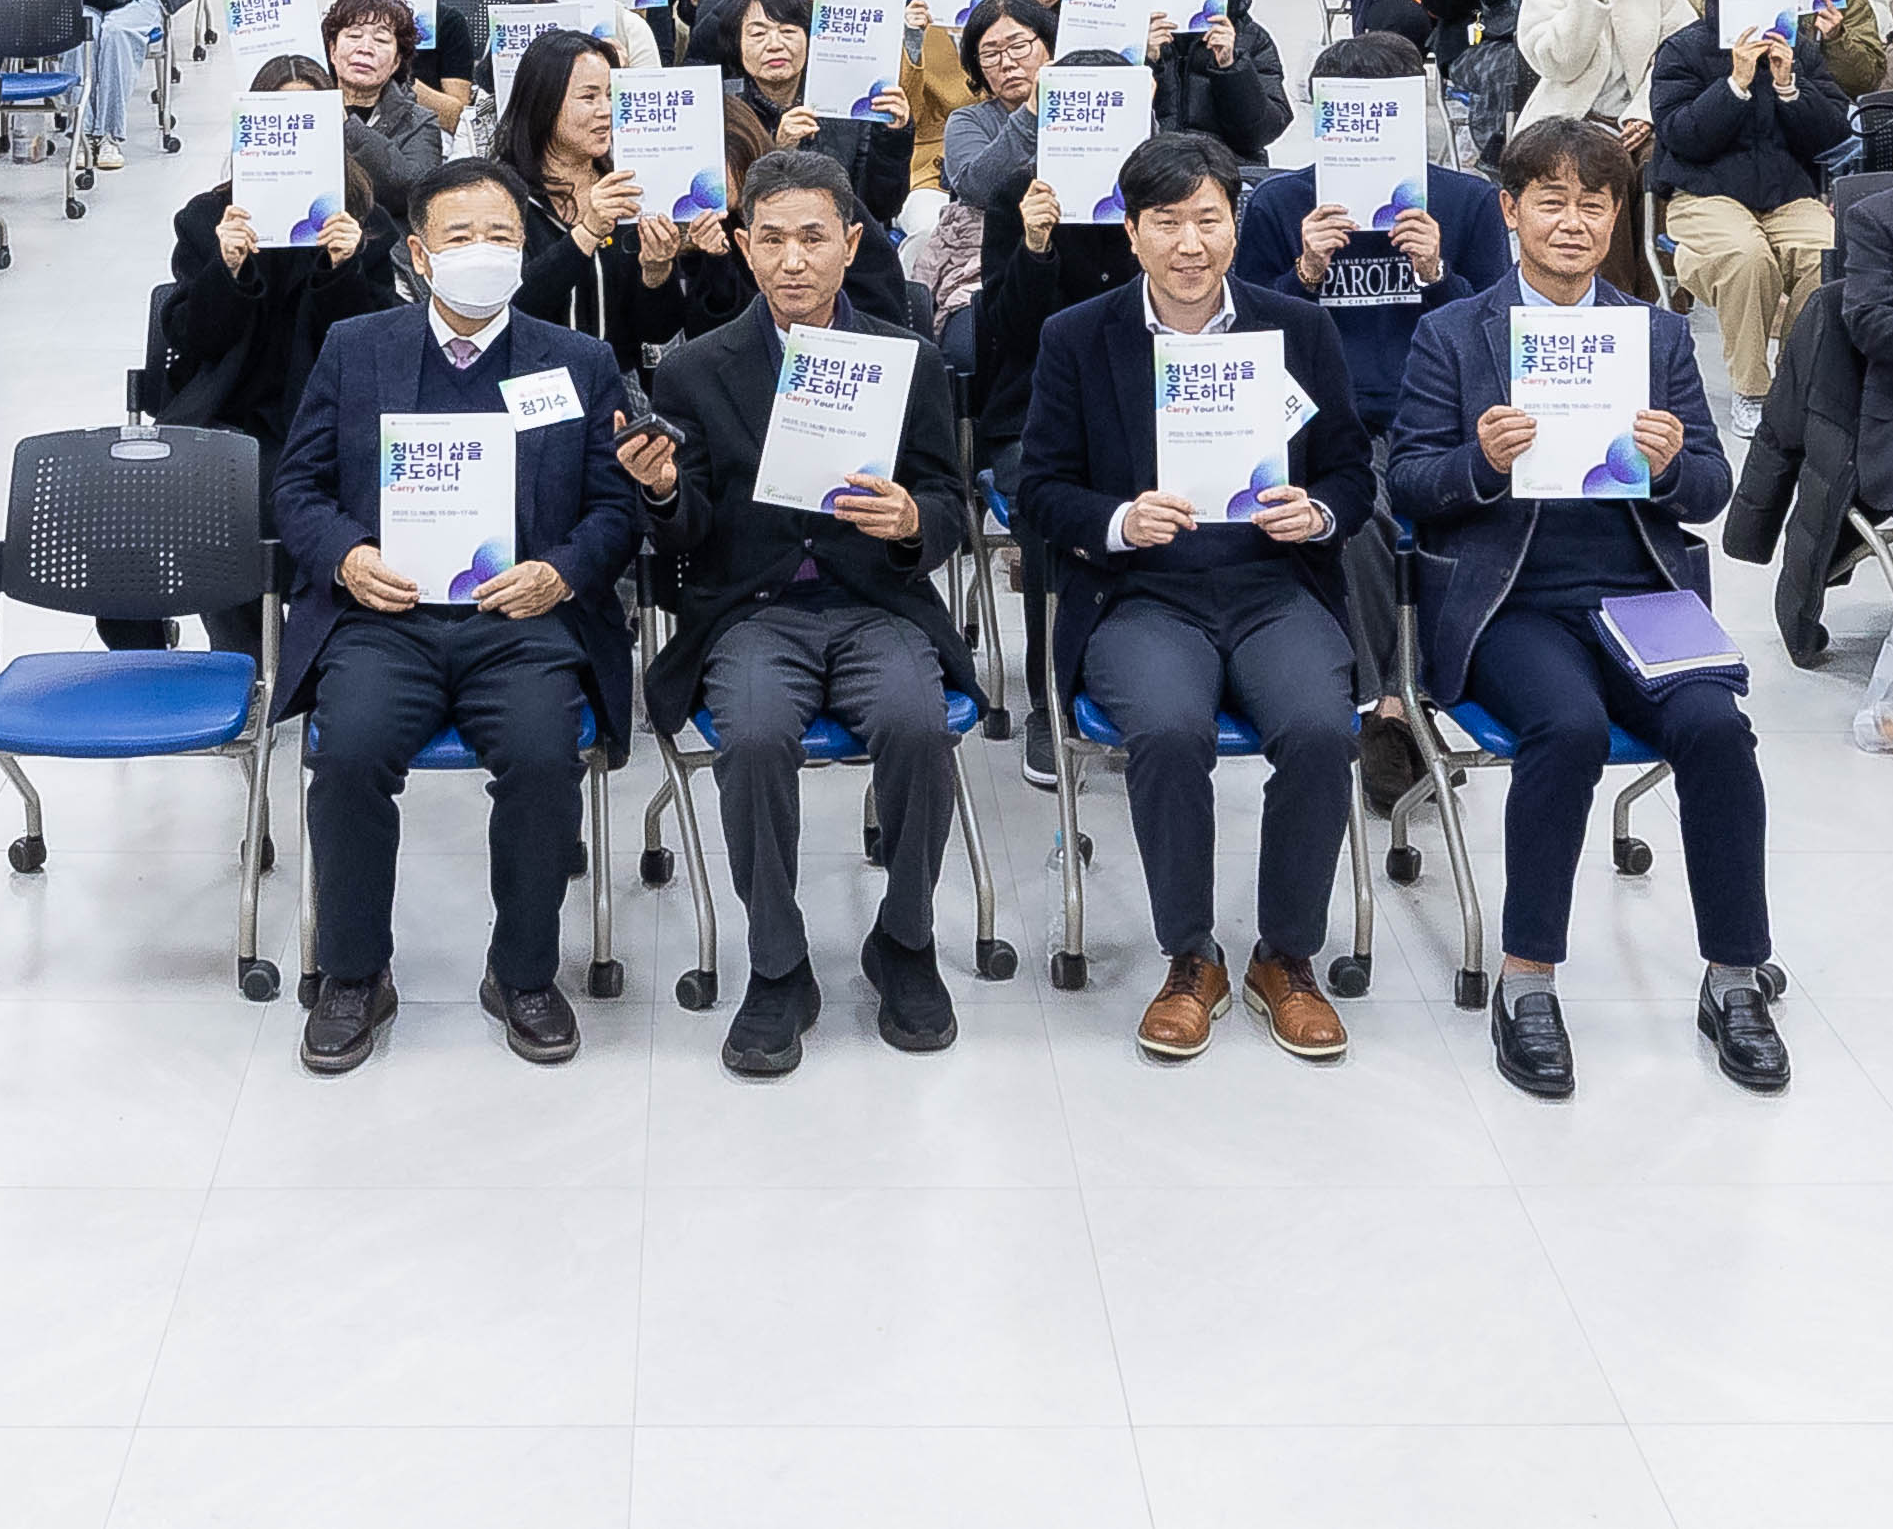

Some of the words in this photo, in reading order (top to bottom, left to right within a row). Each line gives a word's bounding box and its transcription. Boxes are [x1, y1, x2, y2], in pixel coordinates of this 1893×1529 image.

[1048, 89, 1091, 106] 청년의
[1095, 90, 1127, 106] 삶을
[239, 114, 282, 131] 청년의
[285, 113, 317, 130] 삶을
[1047, 106, 1106, 123] 주도하다
[239, 131, 298, 147] 주도하다
[1320, 262, 1421, 296] PAROLE
[1522, 333, 1575, 353] 청년의
[1580, 333, 1619, 353] 삶을
[794, 353, 845, 378] 청년의
[849, 363, 886, 384] 삶을
[1165, 362, 1216, 382] 청년의
[1221, 360, 1260, 381] 삶을
[1522, 354, 1594, 373] 주도하다
[789, 373, 859, 400] 주도하다
[1521, 375, 1549, 386] Carry
[1549, 376, 1573, 385] Your
[1573, 376, 1594, 385] Life
[1166, 382, 1236, 402] 주도하다
[519, 394, 568, 416] 정기수
[786, 393, 812, 406] Carry
[813, 398, 836, 408] Your
[835, 401, 855, 411] Life
[1166, 404, 1192, 415] Carry
[1192, 404, 1216, 413] Your
[1216, 403, 1236, 413] Life
[391, 441, 442, 461] 청년의
[448, 440, 486, 461] 삶을
[390, 462, 462, 481] 주도하다
[390, 482, 416, 493] Carry
[417, 483, 441, 492] Your
[440, 483, 461, 492] Life
